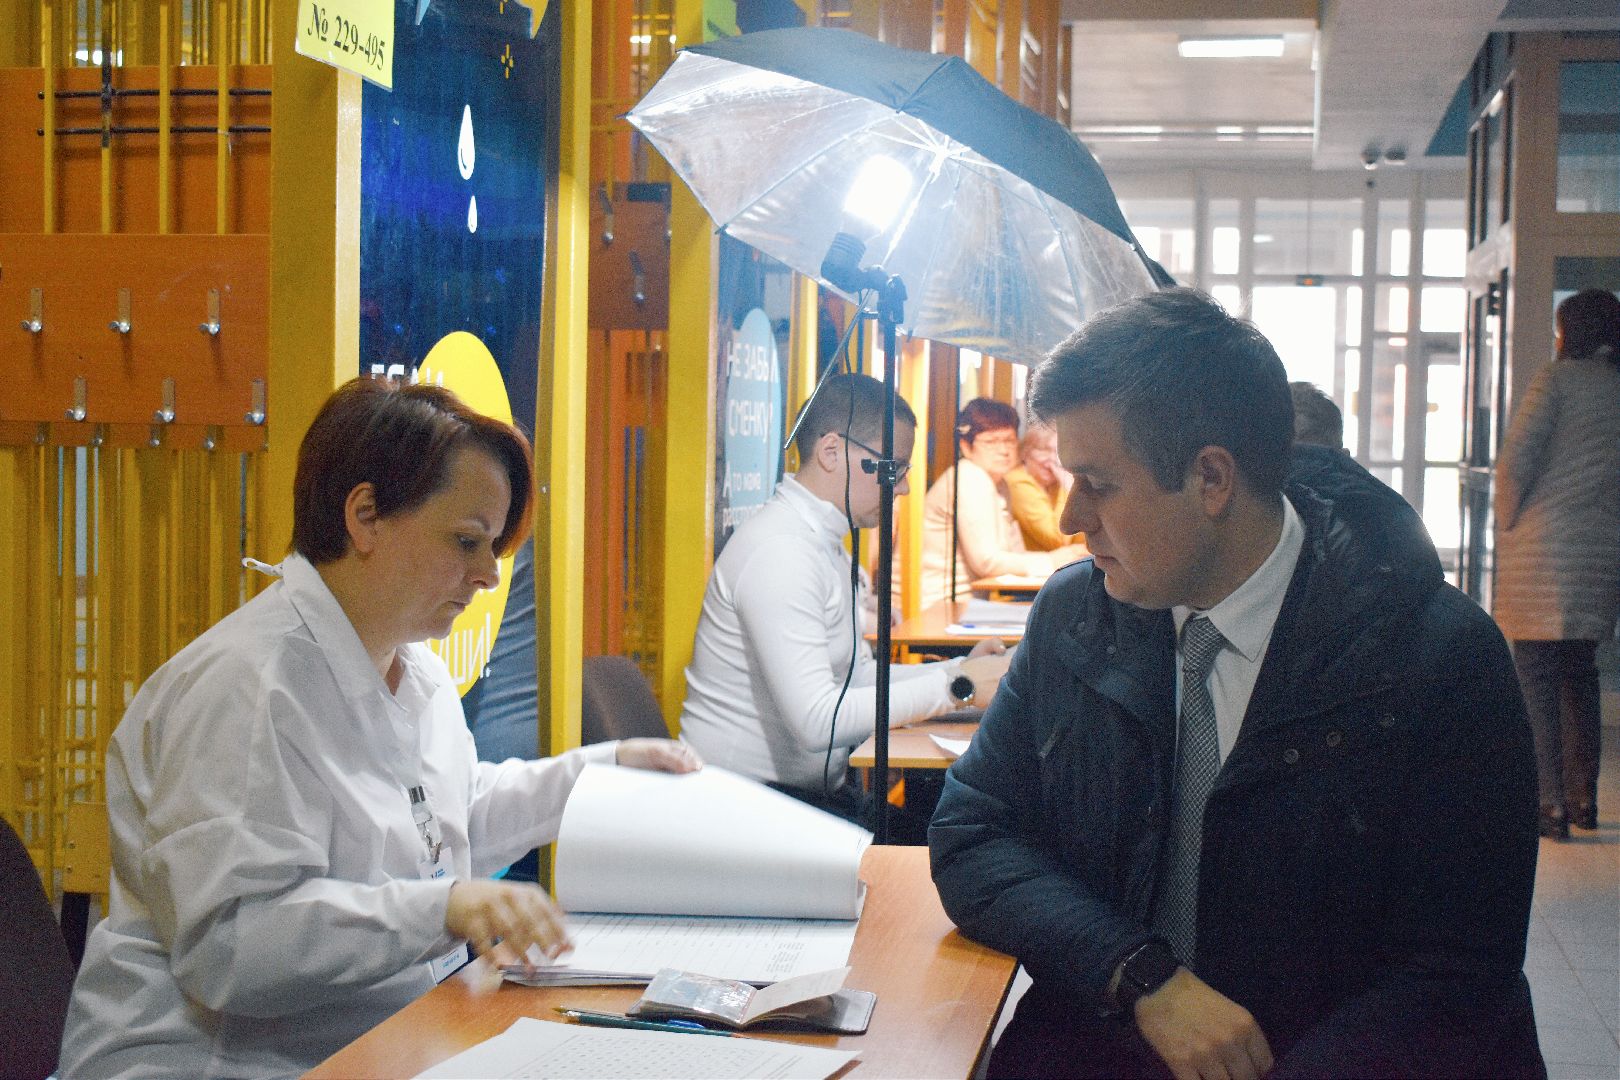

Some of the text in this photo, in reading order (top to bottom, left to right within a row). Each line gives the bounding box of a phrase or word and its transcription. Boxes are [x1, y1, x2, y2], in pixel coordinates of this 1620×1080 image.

[307, 3, 386, 71] № 229-495
[726, 340, 742, 378] НЕ
